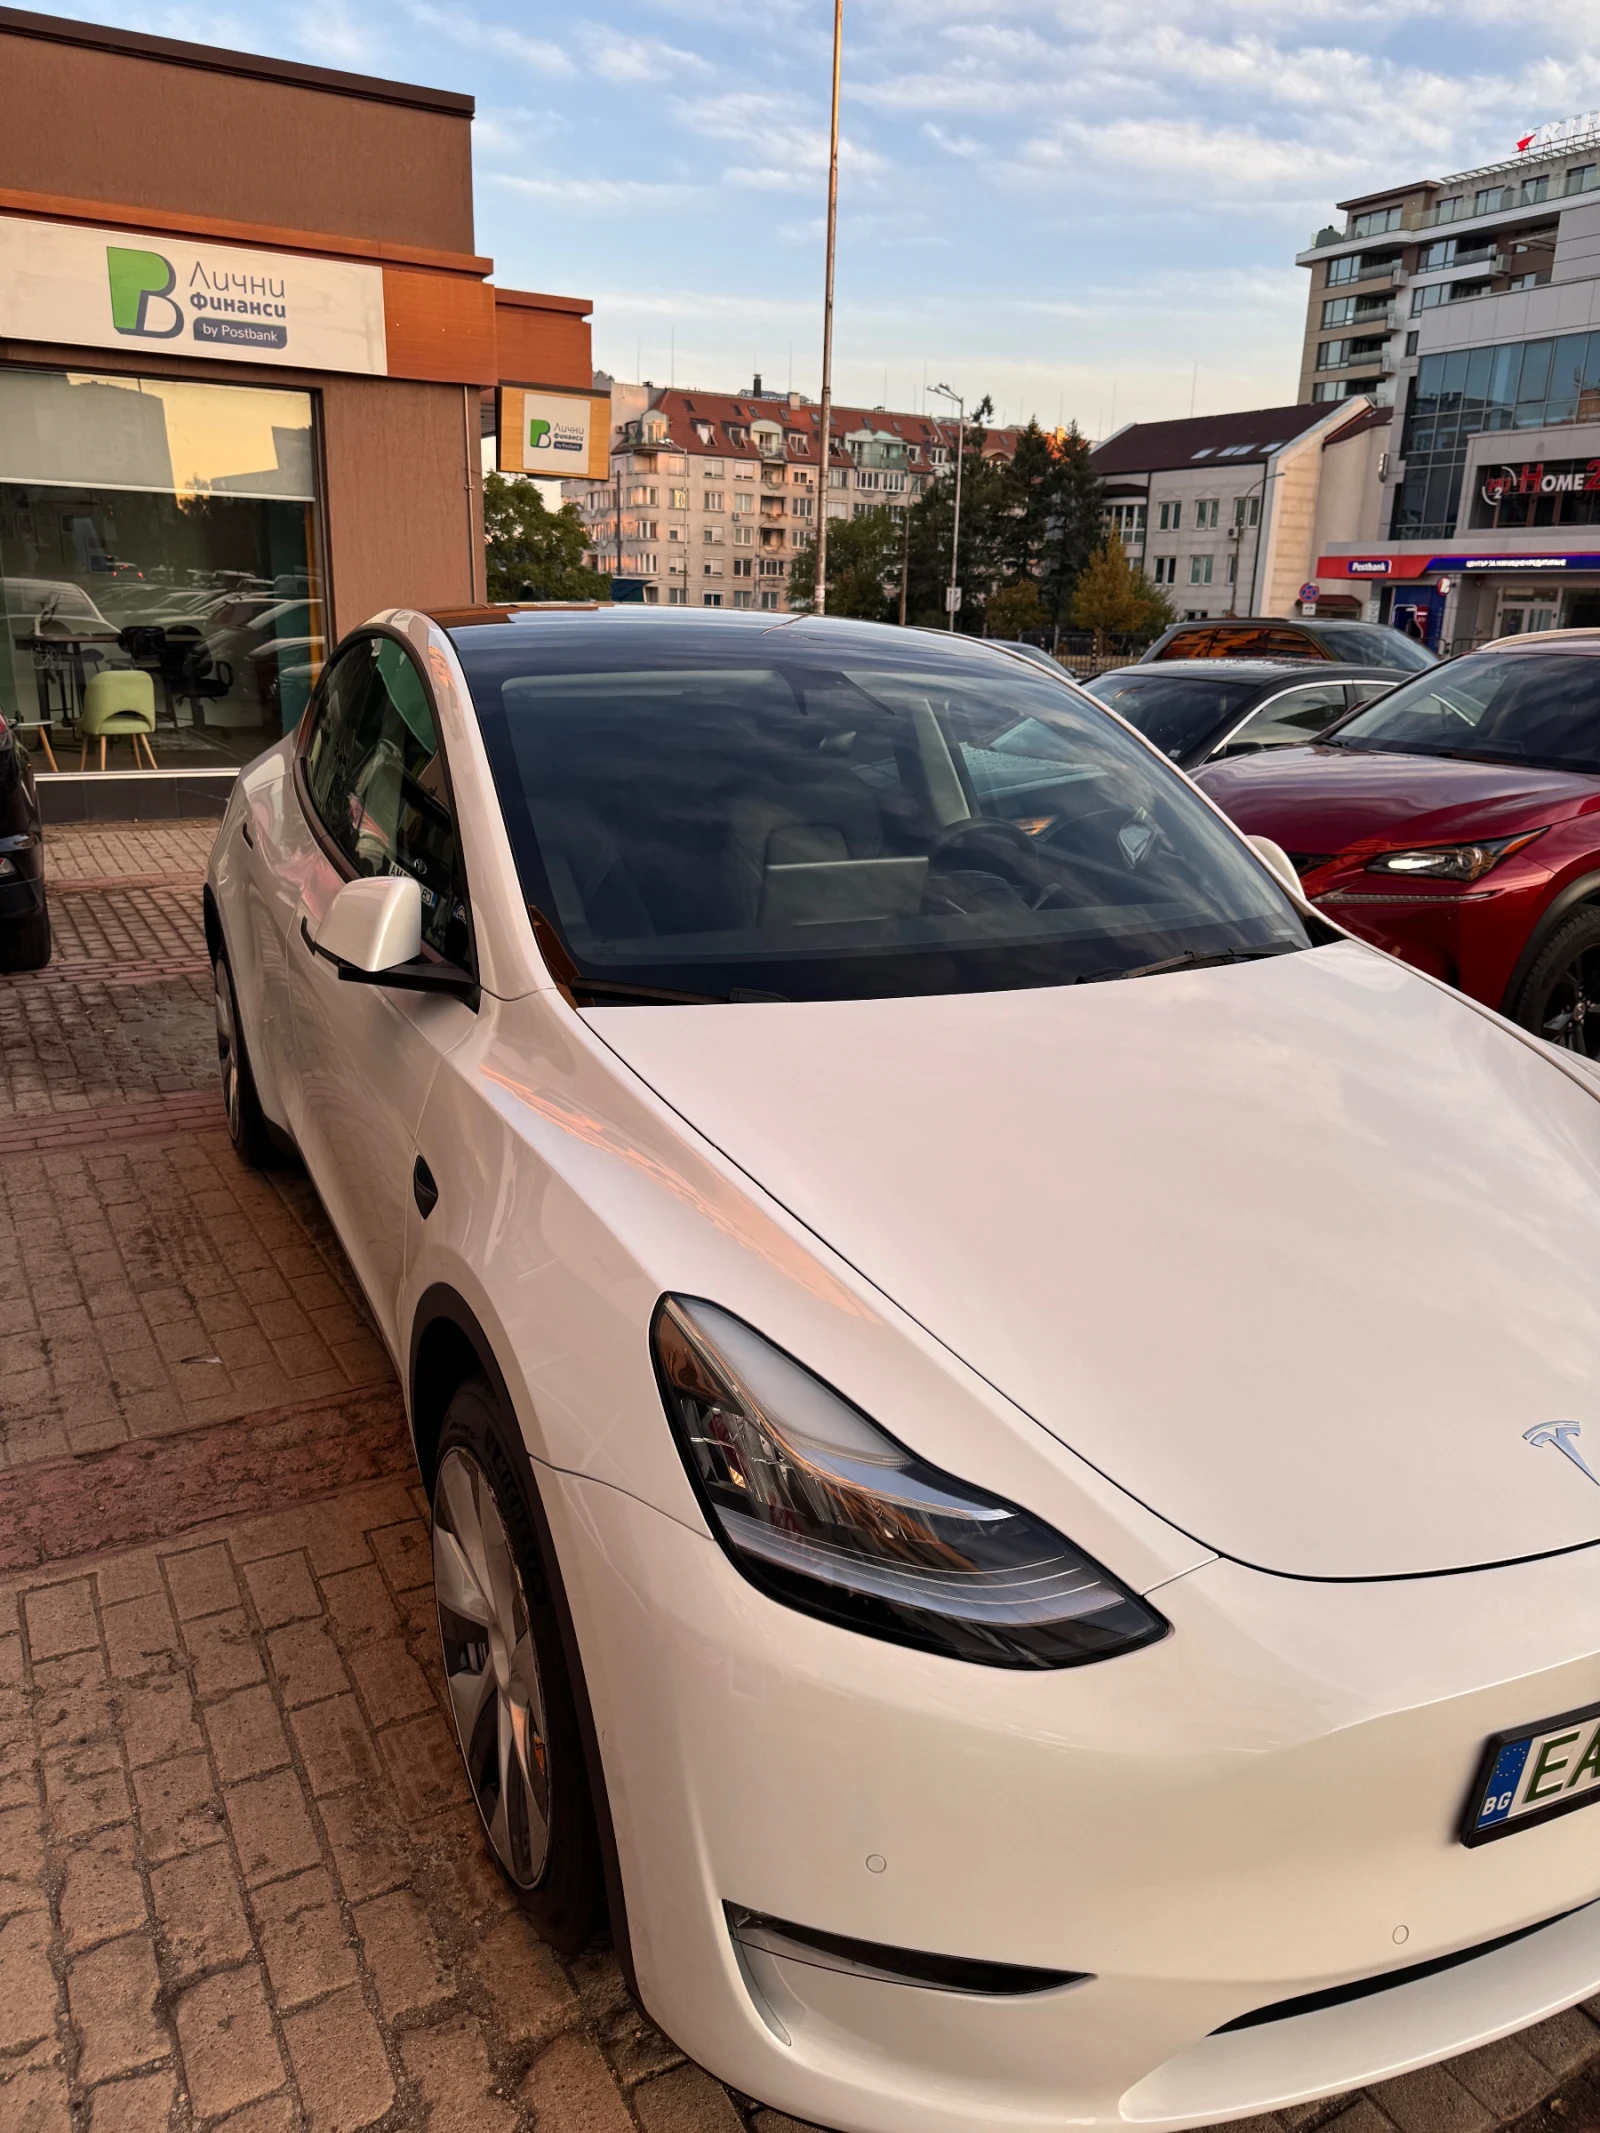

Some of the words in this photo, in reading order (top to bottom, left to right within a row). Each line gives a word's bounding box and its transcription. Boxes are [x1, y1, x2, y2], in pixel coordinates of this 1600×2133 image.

[189, 260, 285, 298] Лични
[189, 291, 287, 319] Финанси
[202, 323, 218, 338] by
[221, 324, 278, 342] Postbank
[553, 422, 585, 435] Лични
[554, 433, 584, 441] Финанси
[1351, 561, 1387, 572] Postbank
[1481, 1791, 1512, 1817] BG
